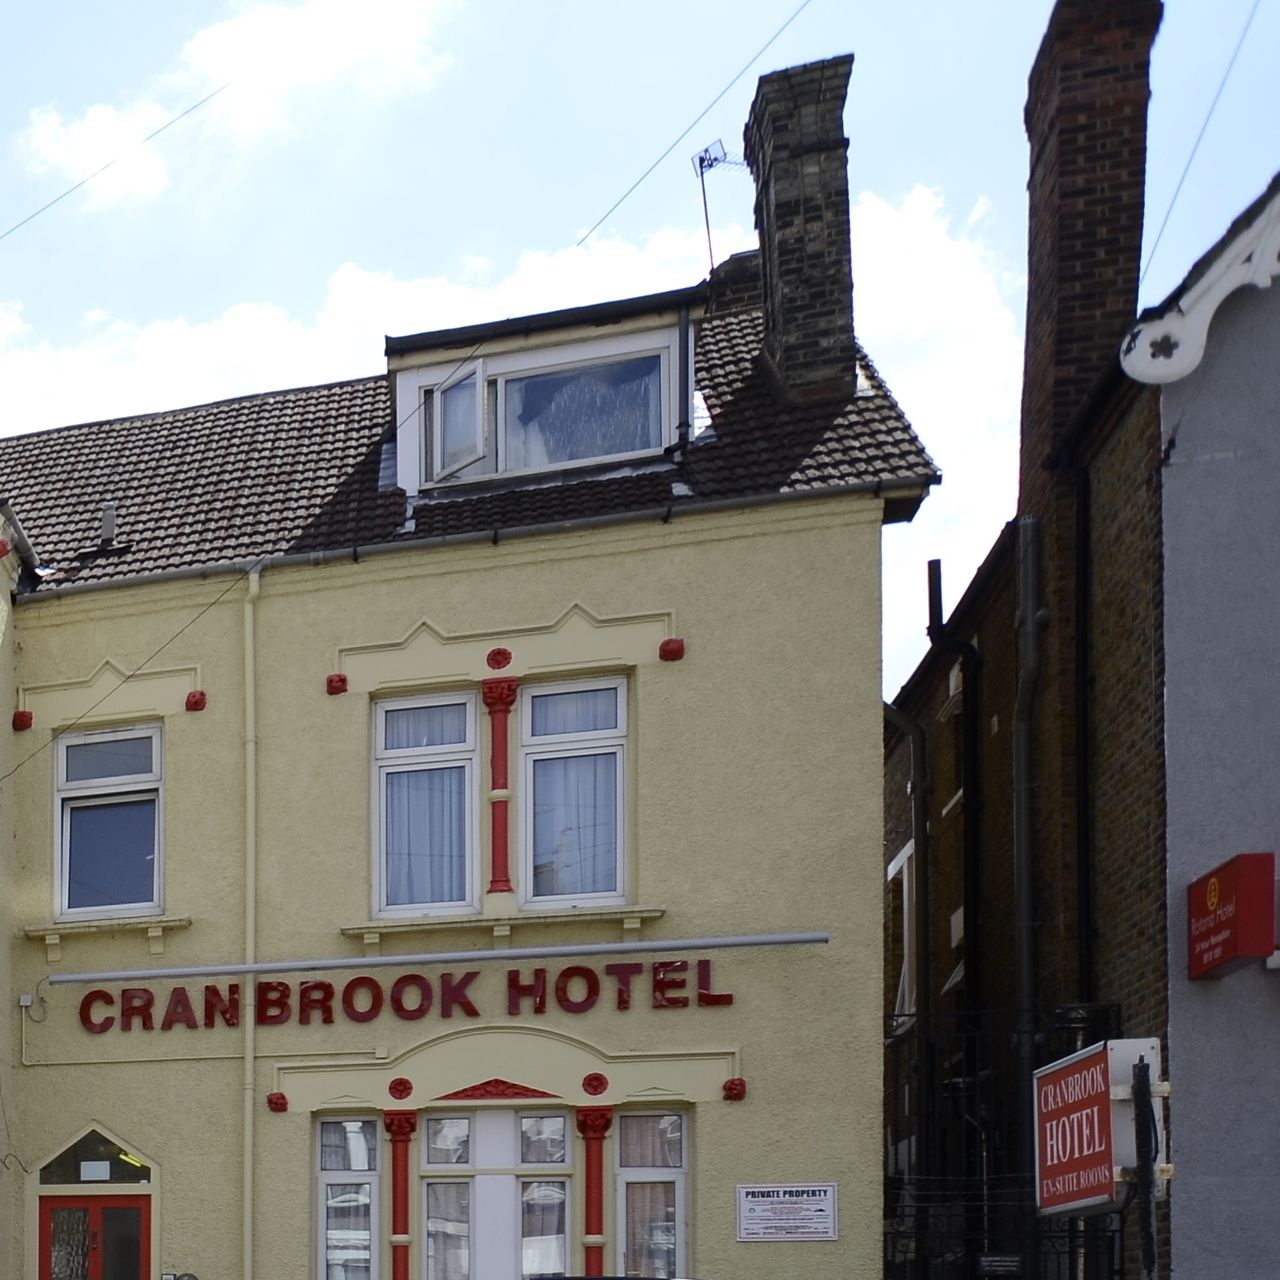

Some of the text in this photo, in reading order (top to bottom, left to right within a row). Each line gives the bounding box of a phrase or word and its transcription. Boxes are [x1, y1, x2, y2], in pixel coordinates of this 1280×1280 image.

[79, 959, 734, 1035] CRANBROOK HOTEL
[1040, 1063, 1105, 1114] CRANBROOK
[1045, 1105, 1106, 1167] HOTEL
[745, 1189, 829, 1199] PRIVATE PROPERTY
[1043, 1163, 1110, 1198] EN-SUITE ROOMS
